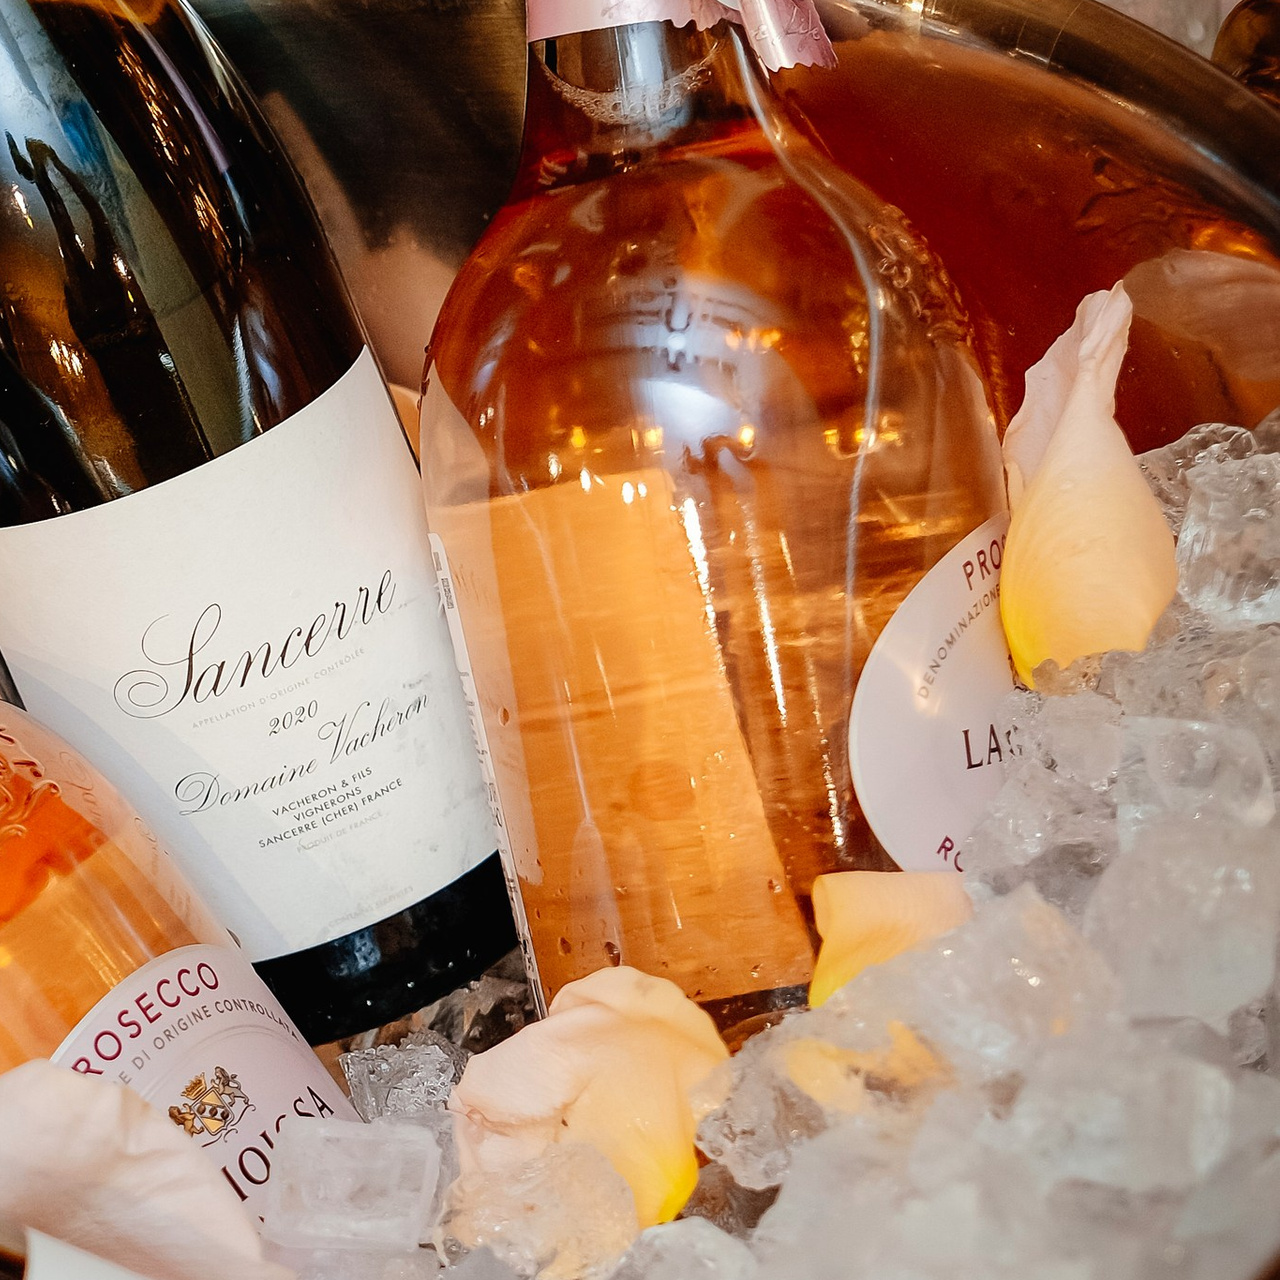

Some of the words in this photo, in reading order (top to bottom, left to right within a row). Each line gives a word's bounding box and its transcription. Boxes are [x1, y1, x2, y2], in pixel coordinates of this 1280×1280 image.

[113, 569, 397, 719] Sancerre
[192, 701, 256, 729] APPELLATION
[259, 676, 311, 706] D'ORIGINE
[314, 646, 366, 680] CONTRÔLÉE
[268, 699, 319, 737] 2020
[174, 757, 319, 816] Domaine
[317, 693, 429, 765] Vacheron
[258, 819, 318, 849] SANCERRE
[321, 801, 359, 826] (CHER)
[360, 777, 403, 807] FRANCE
[271, 784, 337, 817] VACHERON
[340, 778, 350, 788] &
[351, 766, 373, 783] FILS
[293, 786, 362, 822] VIGNERONS
[349, 811, 383, 831] FRANCE
[71, 961, 220, 1076] ROSECCO
[131, 1049, 152, 1071] DI
[152, 1004, 213, 1051] ORIGINE
